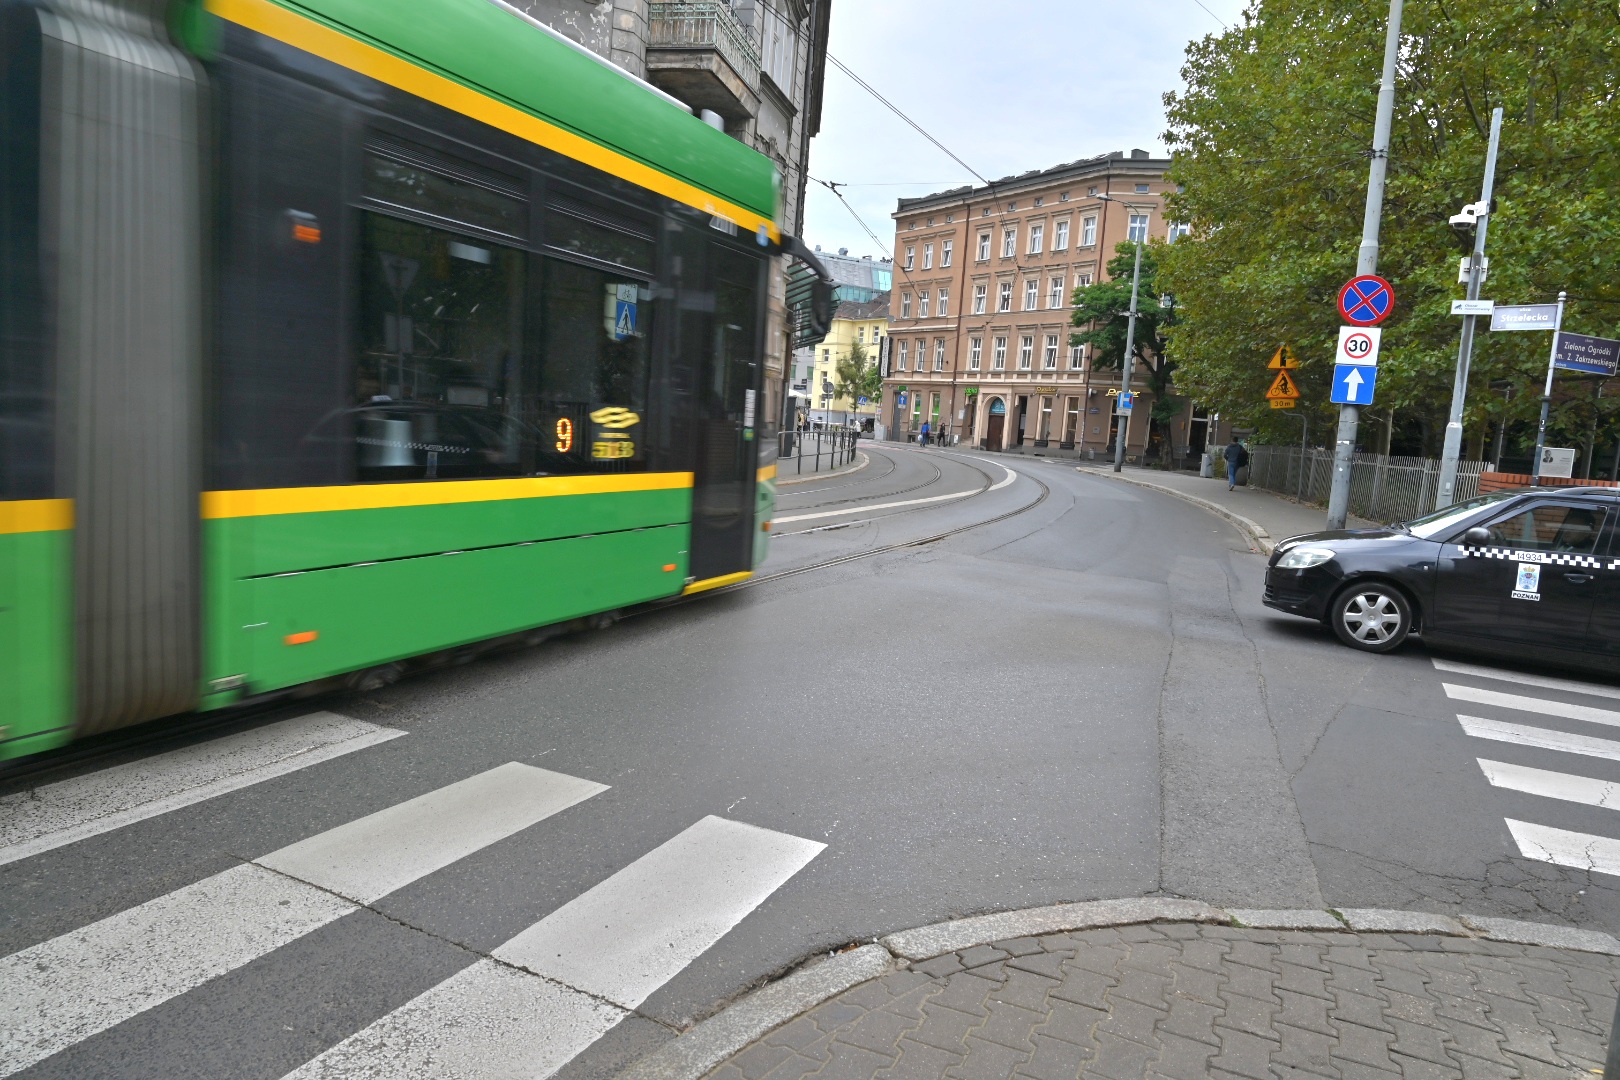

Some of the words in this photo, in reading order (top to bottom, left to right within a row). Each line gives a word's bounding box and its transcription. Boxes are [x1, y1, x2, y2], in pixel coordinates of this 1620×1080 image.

[1500, 313, 1549, 323] Strzelecka
[1348, 339, 1369, 352] 30
[1564, 341, 1586, 352] Zielone
[1588, 345, 1612, 356] Ogródki
[1567, 353, 1573, 361] Z.
[1575, 354, 1616, 369] Zakrzewskiego
[556, 417, 573, 453] 9
[1517, 552, 1542, 562] 14934
